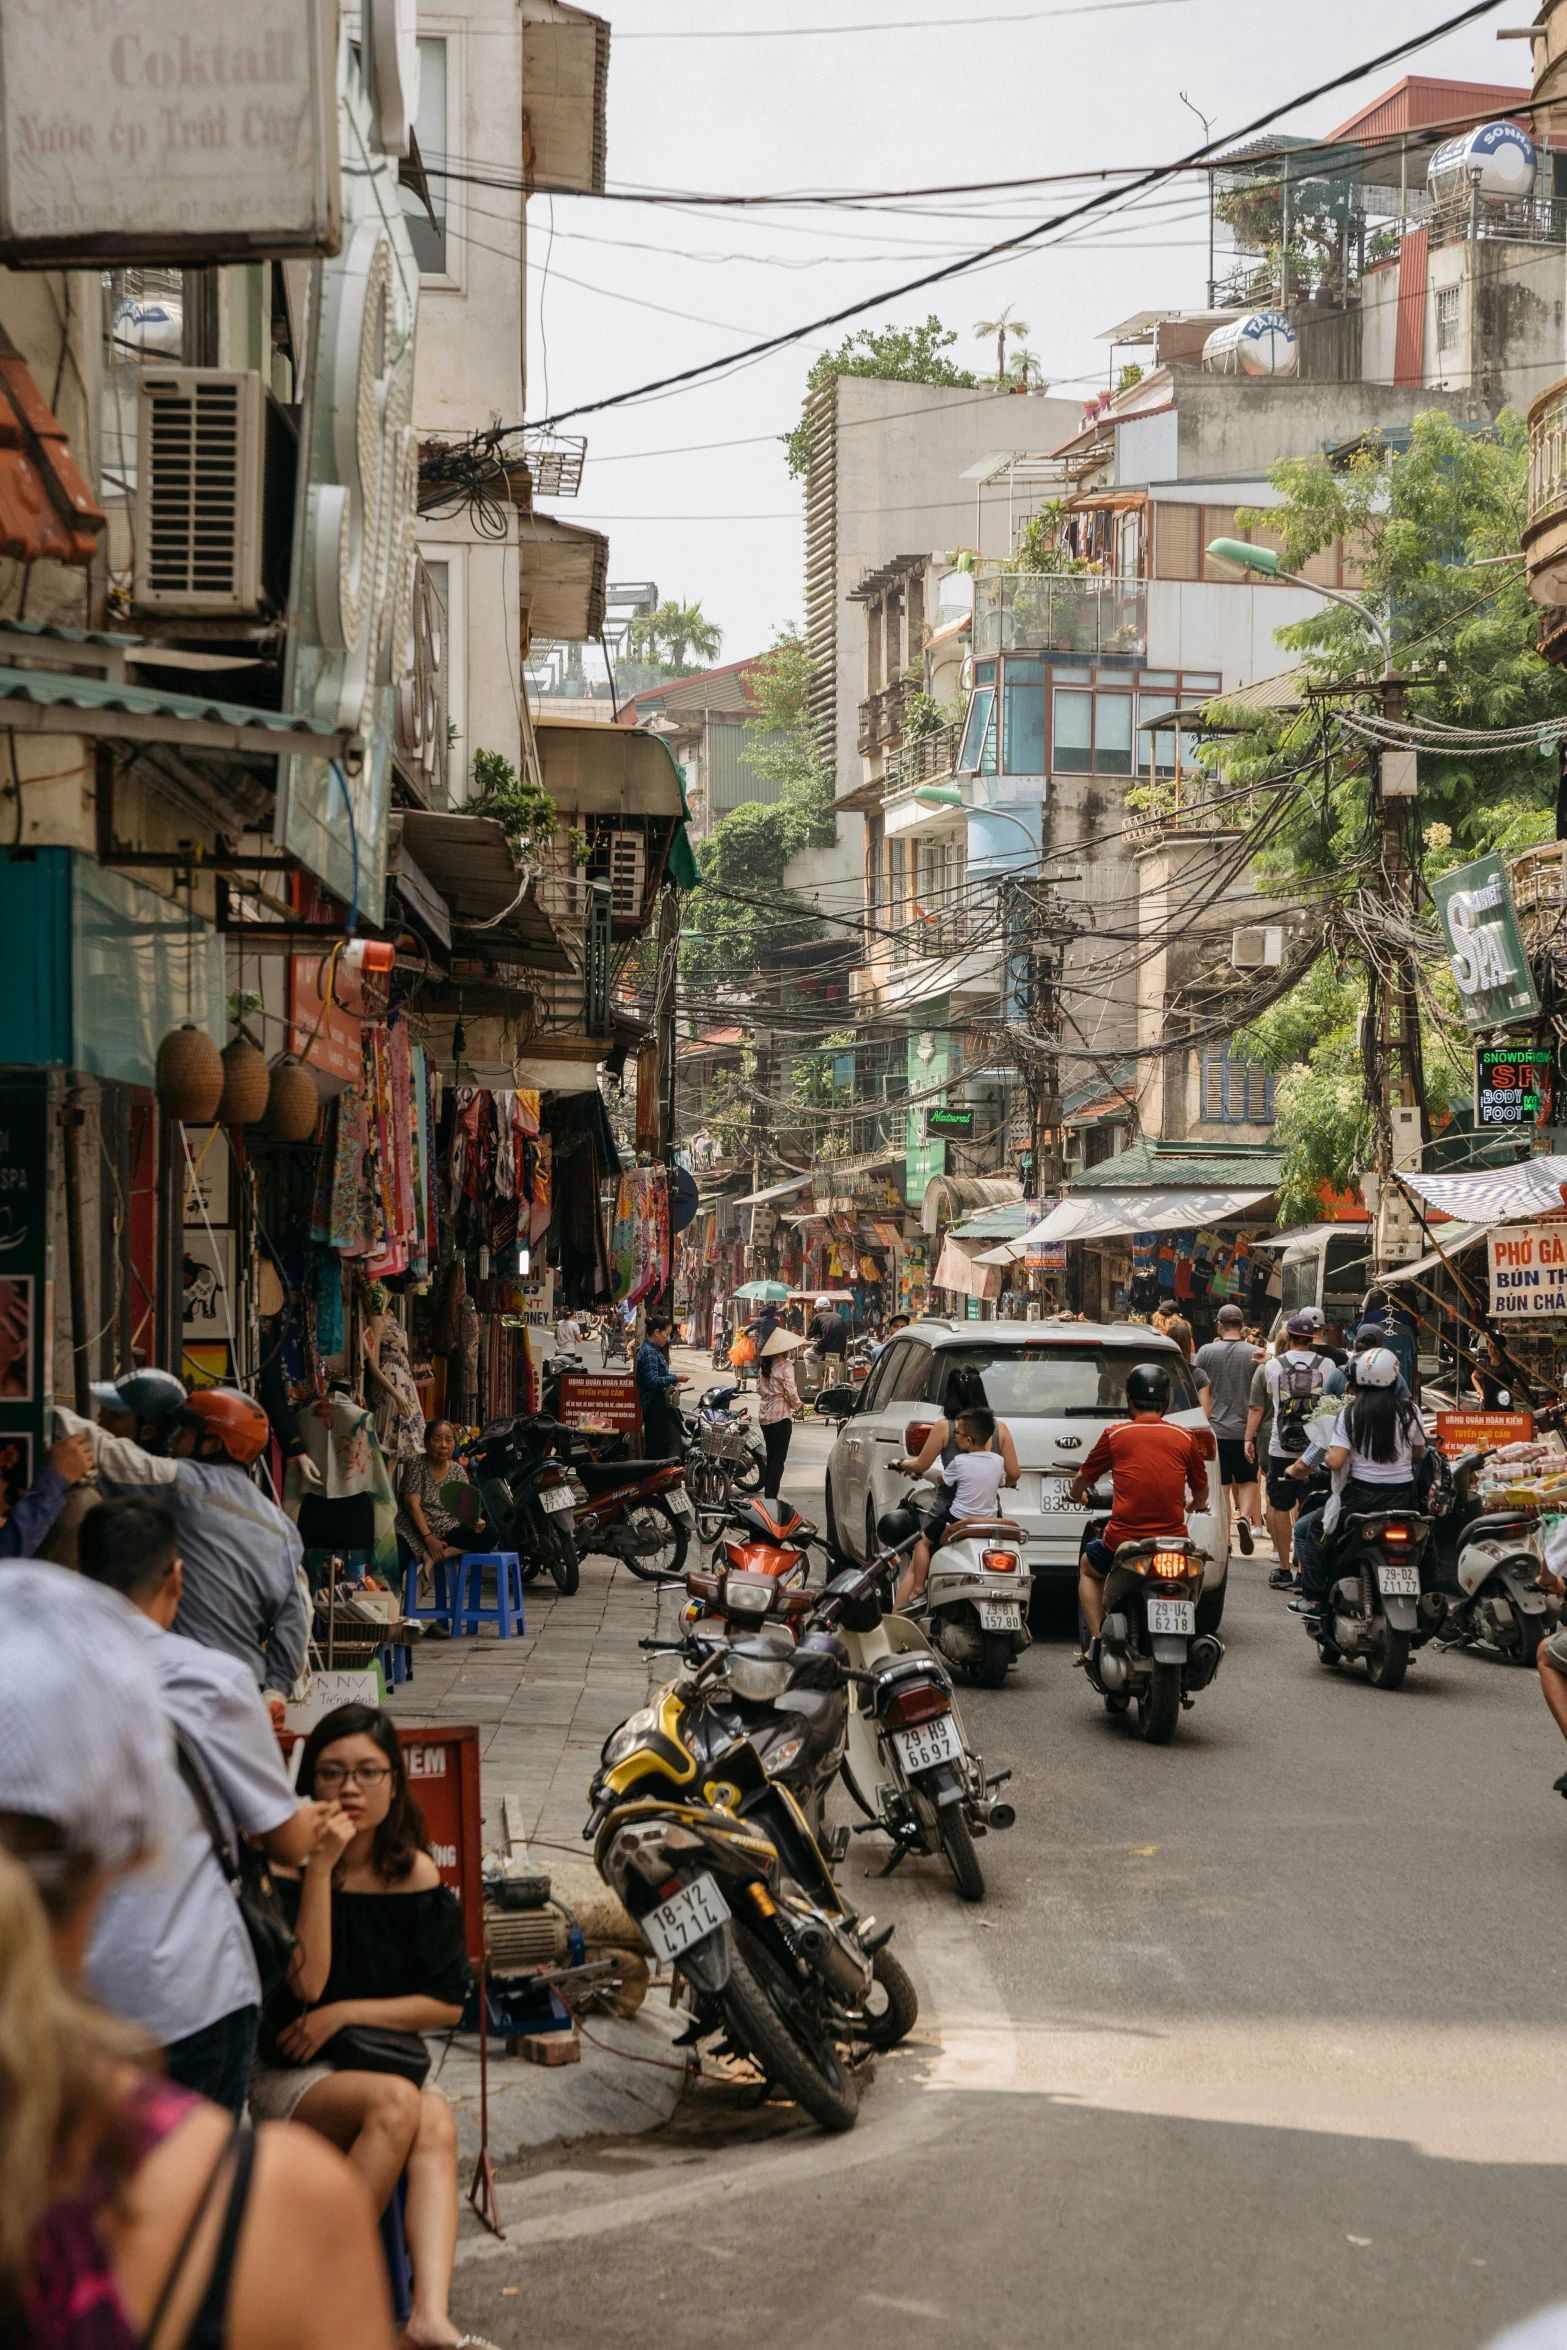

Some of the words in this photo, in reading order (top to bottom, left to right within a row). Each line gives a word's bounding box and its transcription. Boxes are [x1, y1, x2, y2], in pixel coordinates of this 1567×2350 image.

[109, 29, 296, 88] Coktail
[1483, 1089, 1522, 1104] BODY
[930, 1110, 971, 1123] Natural
[1483, 1106, 1523, 1121] FOOT
[1495, 1230, 1534, 1266] PHỞ
[1539, 1233, 1565, 1264] GÀ
[1497, 1268, 1539, 1288] BÚN
[1496, 1293, 1528, 1311] BÚN
[1534, 1286, 1567, 1310] CHẢ
[1060, 1438, 1078, 1447] KIA
[1385, 1569, 1413, 1580] 29-D2
[1383, 1581, 1416, 1592] 211.27
[987, 1603, 1014, 1615] 29-B1
[1156, 1603, 1187, 1617] 29-U4
[985, 1617, 1019, 1628] 157.80
[1156, 1617, 1187, 1631] 6218
[902, 1721, 947, 1750] 29-H9
[908, 1740, 950, 1768] 6697
[654, 1885, 707, 1931] 18-Y2
[664, 1906, 718, 1953] 4714
